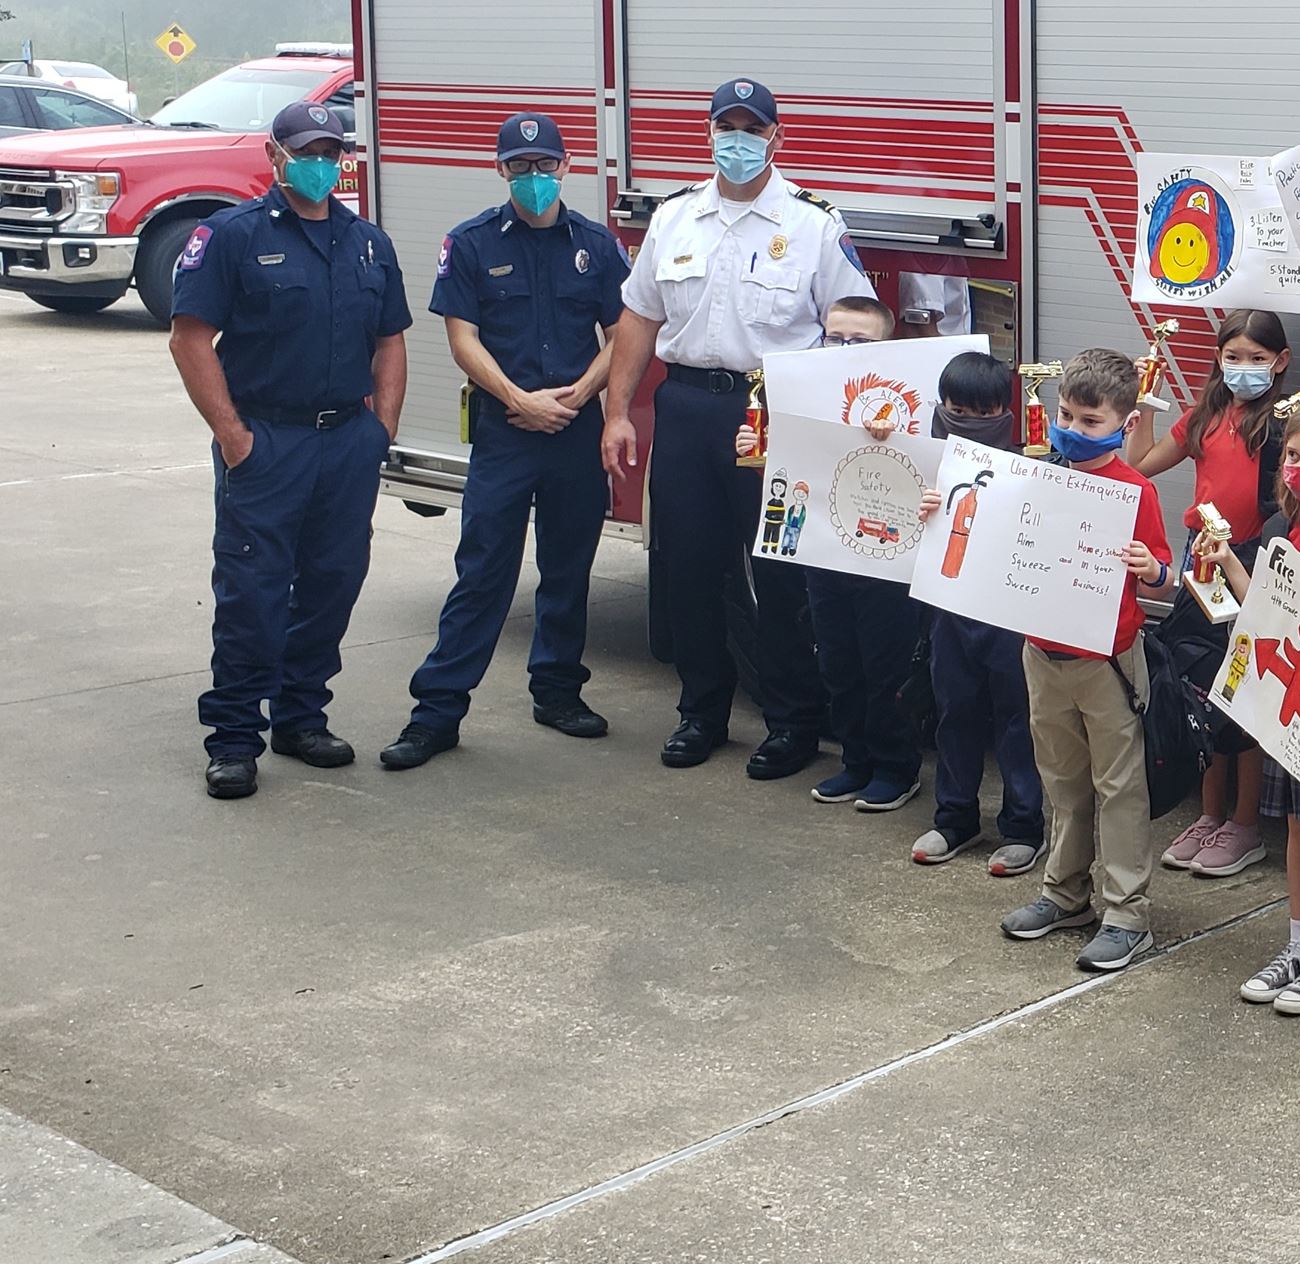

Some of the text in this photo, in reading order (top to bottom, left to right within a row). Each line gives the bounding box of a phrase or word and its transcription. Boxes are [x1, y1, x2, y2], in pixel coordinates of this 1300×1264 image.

[1266, 229, 1284, 240] your
[859, 395, 871, 406] Be
[953, 443, 967, 459] Fire
[858, 466, 882, 480] Fire
[1010, 458, 1028, 477] Use
[1031, 466, 1039, 477] A
[1043, 468, 1062, 485] Fire
[1019, 502, 1041, 527] Pull
[1080, 521, 1093, 531] At
[1016, 532, 1036, 549] Aim
[1011, 552, 1052, 573] Squeeze
[1094, 563, 1114, 574] your
[1269, 544, 1295, 585] Fire
[1005, 572, 1040, 596] Sweep
